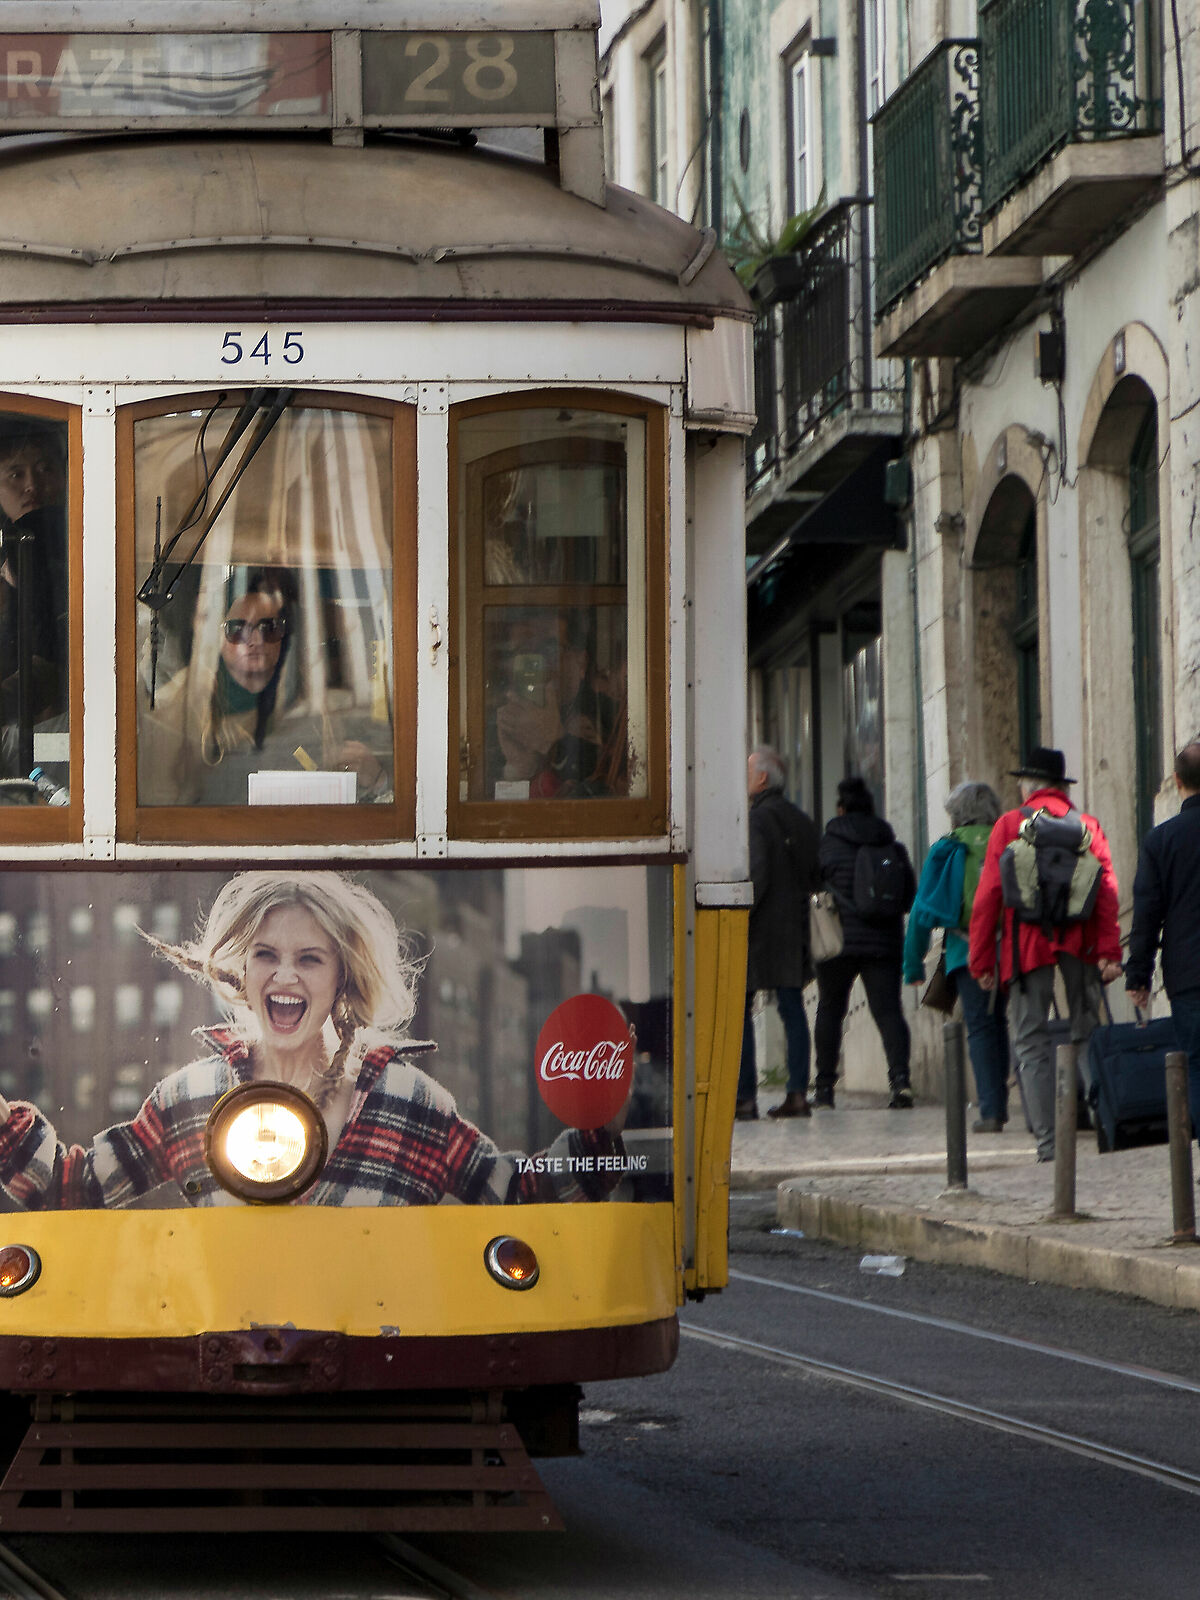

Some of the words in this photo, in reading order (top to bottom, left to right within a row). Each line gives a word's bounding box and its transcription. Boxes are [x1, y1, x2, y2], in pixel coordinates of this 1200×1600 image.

[403, 32, 518, 102] 28
[220, 330, 305, 366] 545
[540, 1040, 630, 1081] Coca-Cola
[515, 1158, 563, 1174] TASTE
[566, 1156, 594, 1172] THE
[597, 1155, 647, 1171] FEELING
